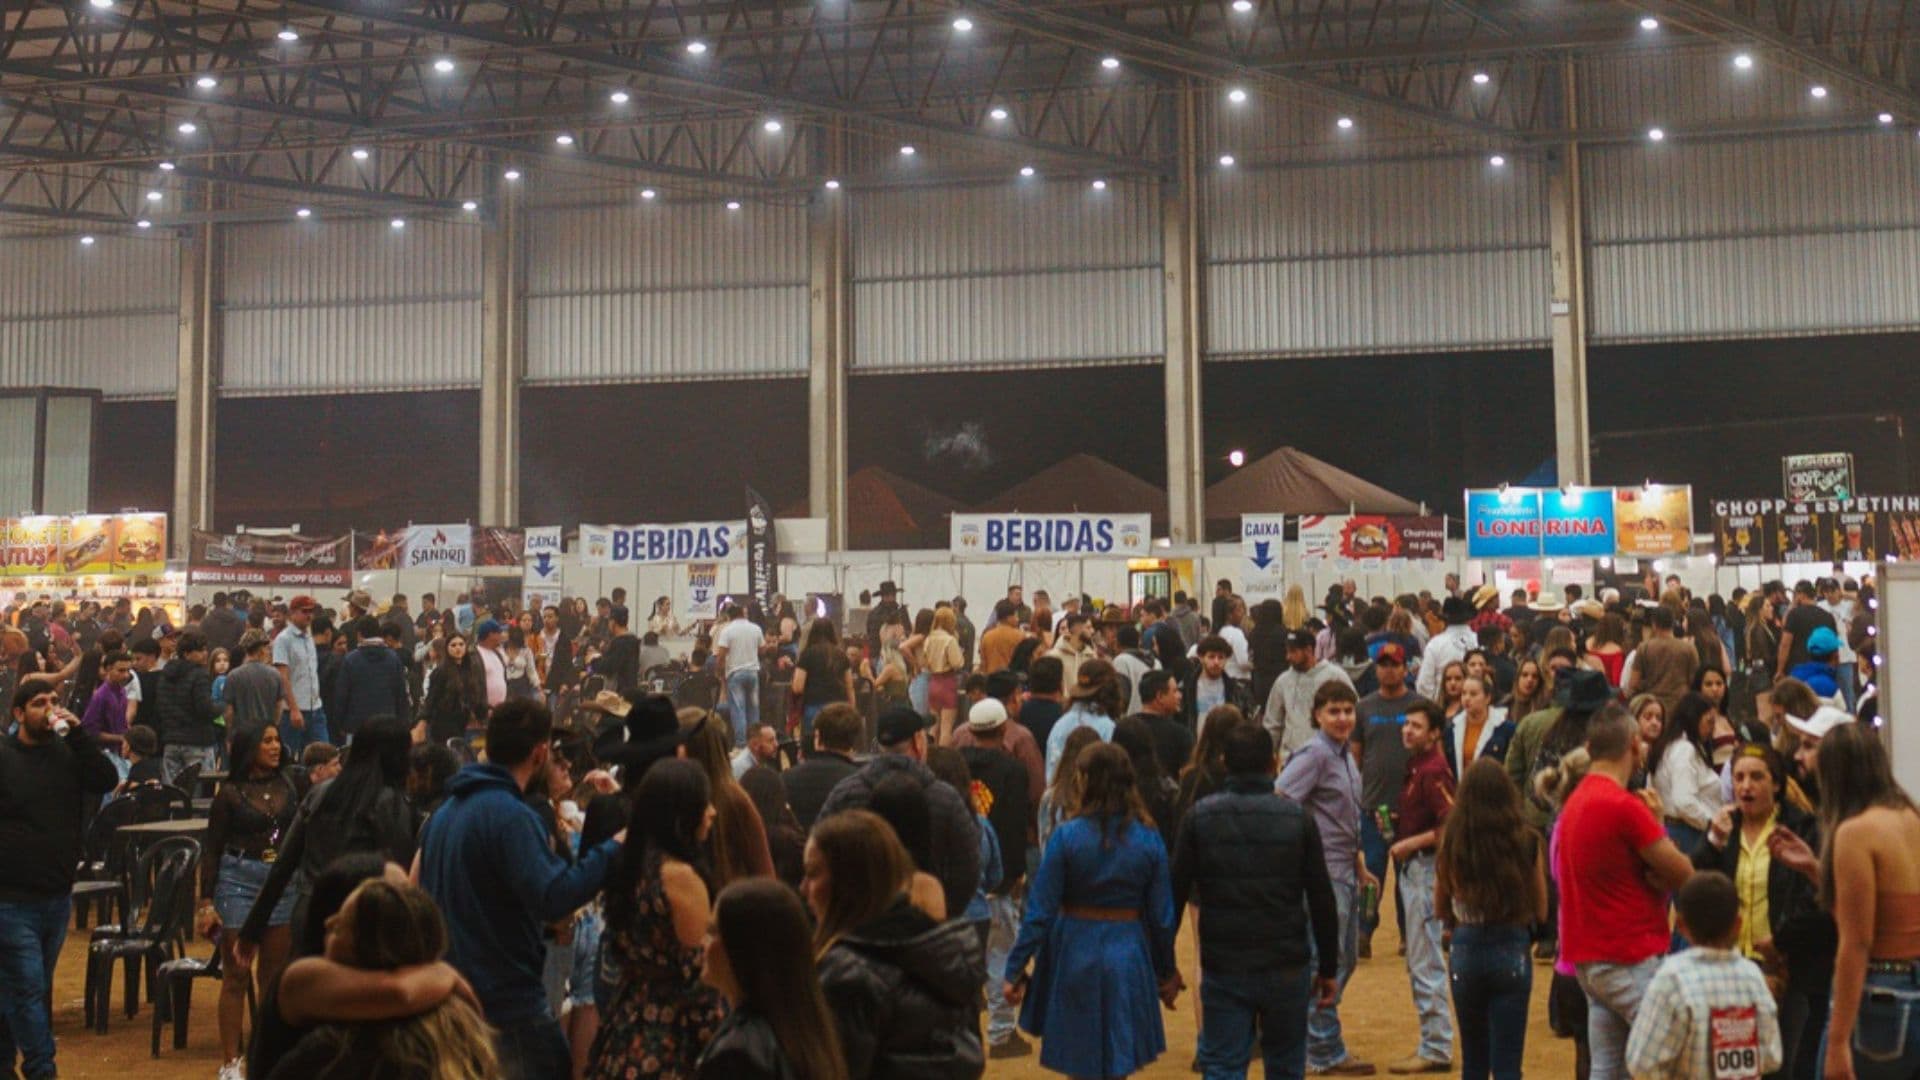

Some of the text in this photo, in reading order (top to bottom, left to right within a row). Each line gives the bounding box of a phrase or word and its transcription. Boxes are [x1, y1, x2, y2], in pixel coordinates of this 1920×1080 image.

[1716, 500, 1787, 516] CHOPP
[1244, 523, 1280, 536] CAIXA
[1476, 517, 1607, 537] LONDRINA
[527, 535, 558, 549] CAIXA
[612, 526, 730, 561] BEBIDAS
[986, 519, 1114, 553] BEBIDAS
[411, 549, 466, 566] SANDRO
[279, 574, 342, 584] CHOPP GELADO
[689, 574, 716, 588] AQUI
